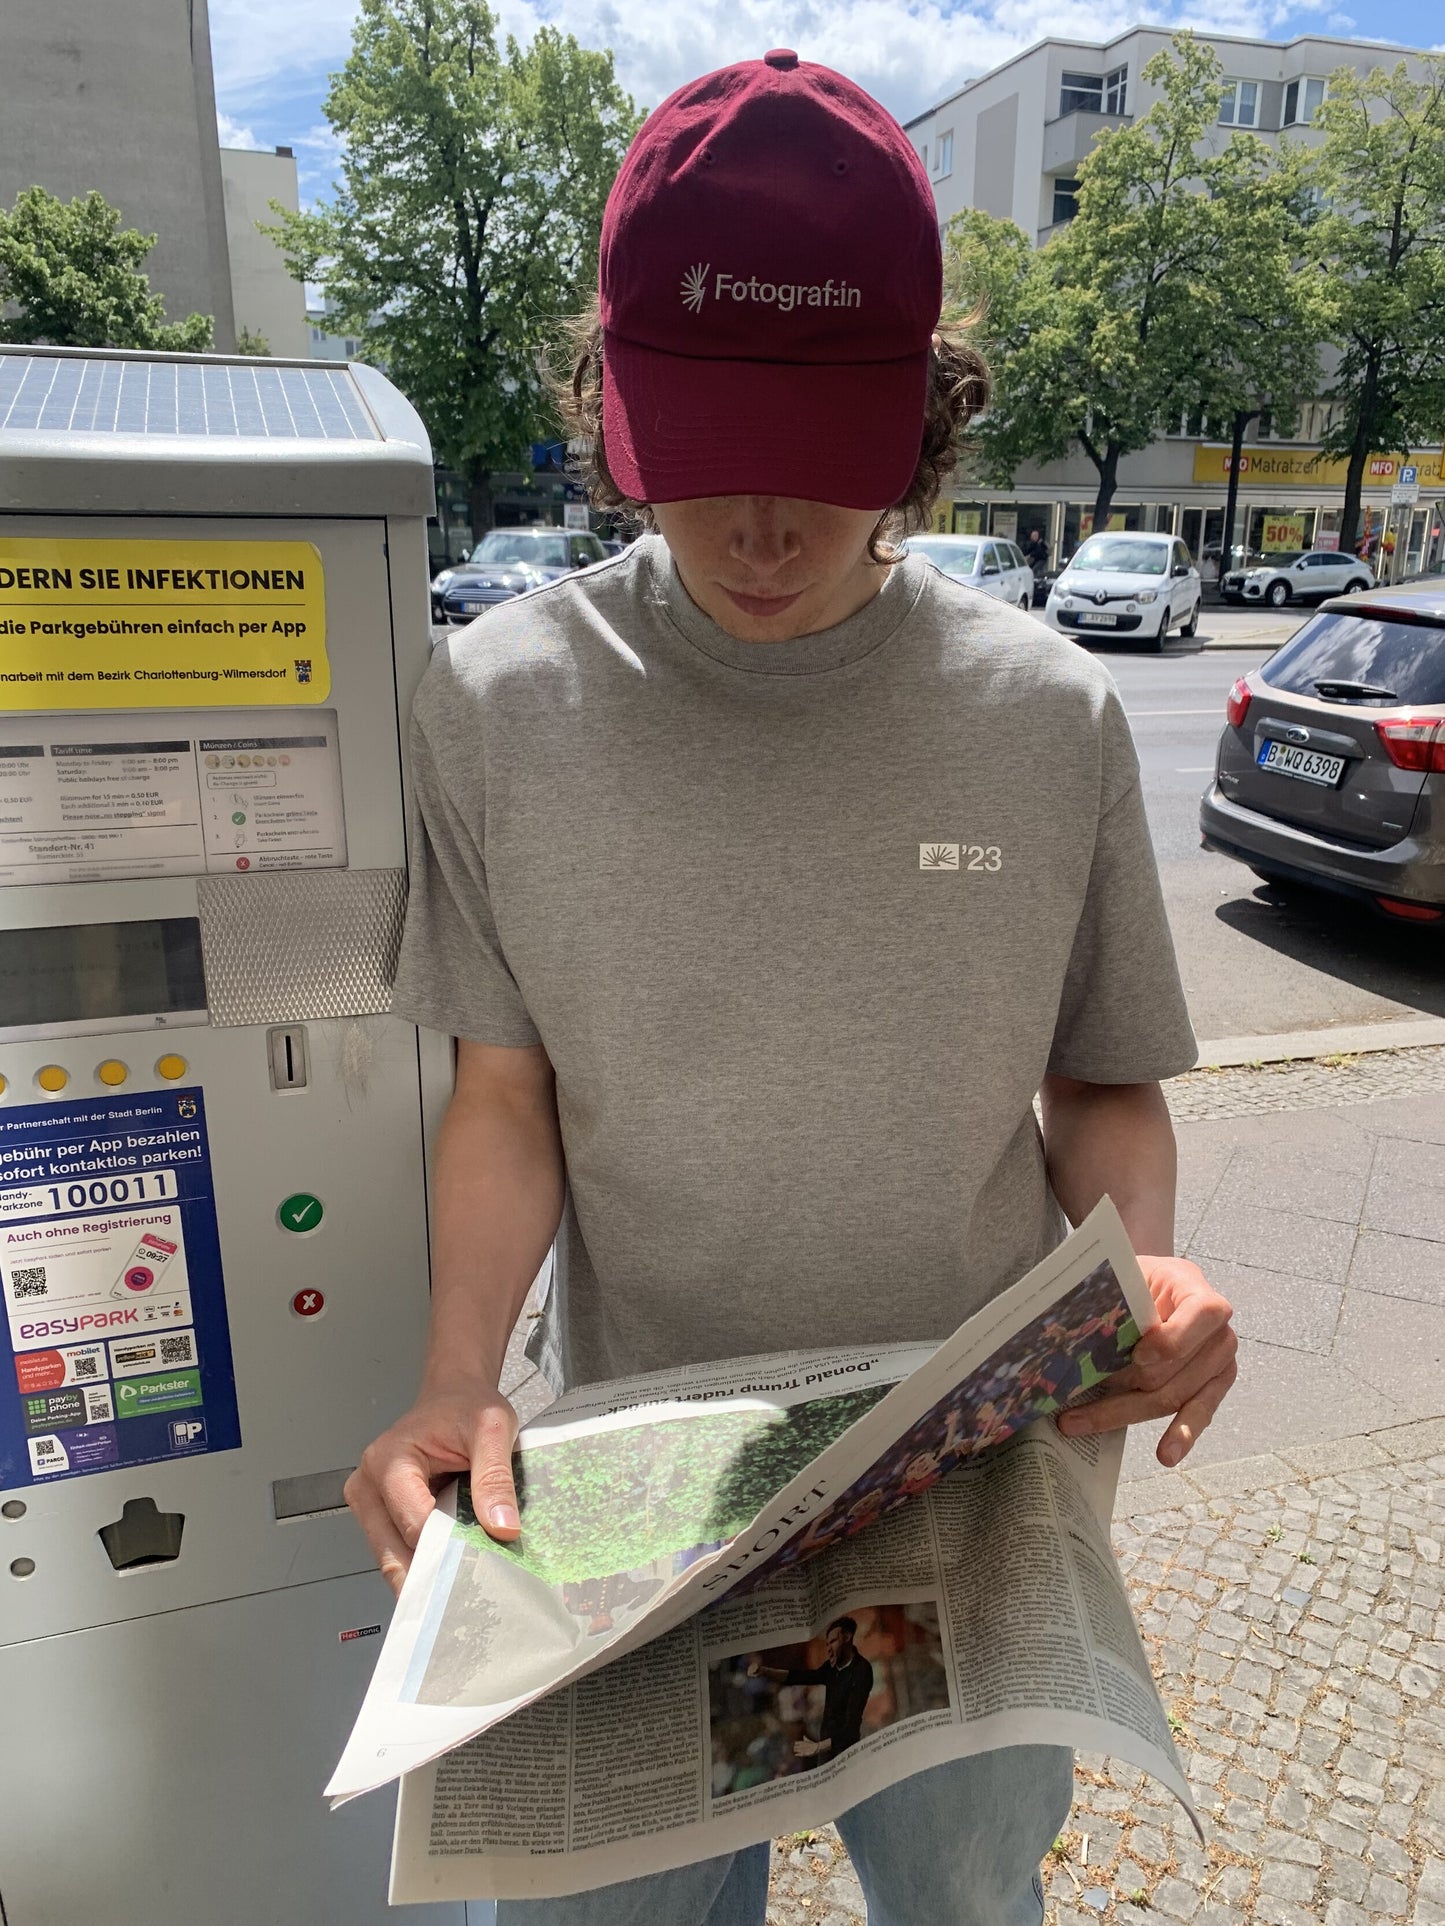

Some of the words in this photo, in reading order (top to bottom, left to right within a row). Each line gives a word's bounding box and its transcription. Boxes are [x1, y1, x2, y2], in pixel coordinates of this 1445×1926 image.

[715, 274, 861, 311] Fotograf:in
[1224, 457, 1248, 471] MO
[1250, 457, 1318, 474] Matratzen
[1371, 461, 1393, 474] MFO
[1266, 525, 1304, 543] 50%
[80, 569, 120, 590] SIE
[127, 569, 305, 590] INFEKTIONEN
[0, 619, 26, 635] die
[30, 619, 163, 640] Parkgebühren
[167, 619, 235, 635] einfach
[239, 624, 268, 640] per
[272, 621, 306, 639] App
[46, 670, 64, 681] mit
[67, 671, 95, 682] dem
[98, 669, 131, 681] Bezirk
[134, 668, 287, 683] Charlottenburg-Wilmersdorf
[237, 741, 258, 749] Coins
[168, 758, 179, 767] pm
[1267, 745, 1278, 762] B
[1284, 749, 1304, 770] WQ
[1303, 755, 1340, 779] 6398
[145, 791, 160, 799] EUR
[150, 799, 164, 807] EUR
[7, 1115, 71, 1132] Partnerschaft
[73, 1113, 88, 1124] mit
[91, 1112, 106, 1122] der
[108, 1109, 133, 1120] Stadt
[135, 1106, 163, 1116] Berlin
[57, 1143, 85, 1159] per
[89, 1138, 122, 1154] App
[127, 1129, 200, 1148] bezahlen
[0, 1166, 44, 1182] sofort
[50, 1154, 137, 1176] kontaktlos
[142, 1145, 202, 1167] parken!
[47, 1174, 168, 1211] 100011
[7, 1230, 42, 1244] Auch
[45, 1225, 80, 1238] ohne
[83, 1213, 172, 1234] Registrierung
[146, 1251, 168, 1263] 09:27
[66, 1347, 101, 1358] mobilet
[21, 1363, 62, 1374] Handyparken
[798, 1363, 813, 1371] und
[806, 1358, 880, 1385] „Donald
[814, 1360, 830, 1368] USA
[776, 1369, 798, 1378] China
[140, 1379, 190, 1395] Parkster
[682, 1384, 703, 1393] durch
[740, 1378, 800, 1394] Trump
[670, 1388, 734, 1403] rudert
[49, 1402, 80, 1414] phone
[702, 1479, 829, 1591] SPORT
